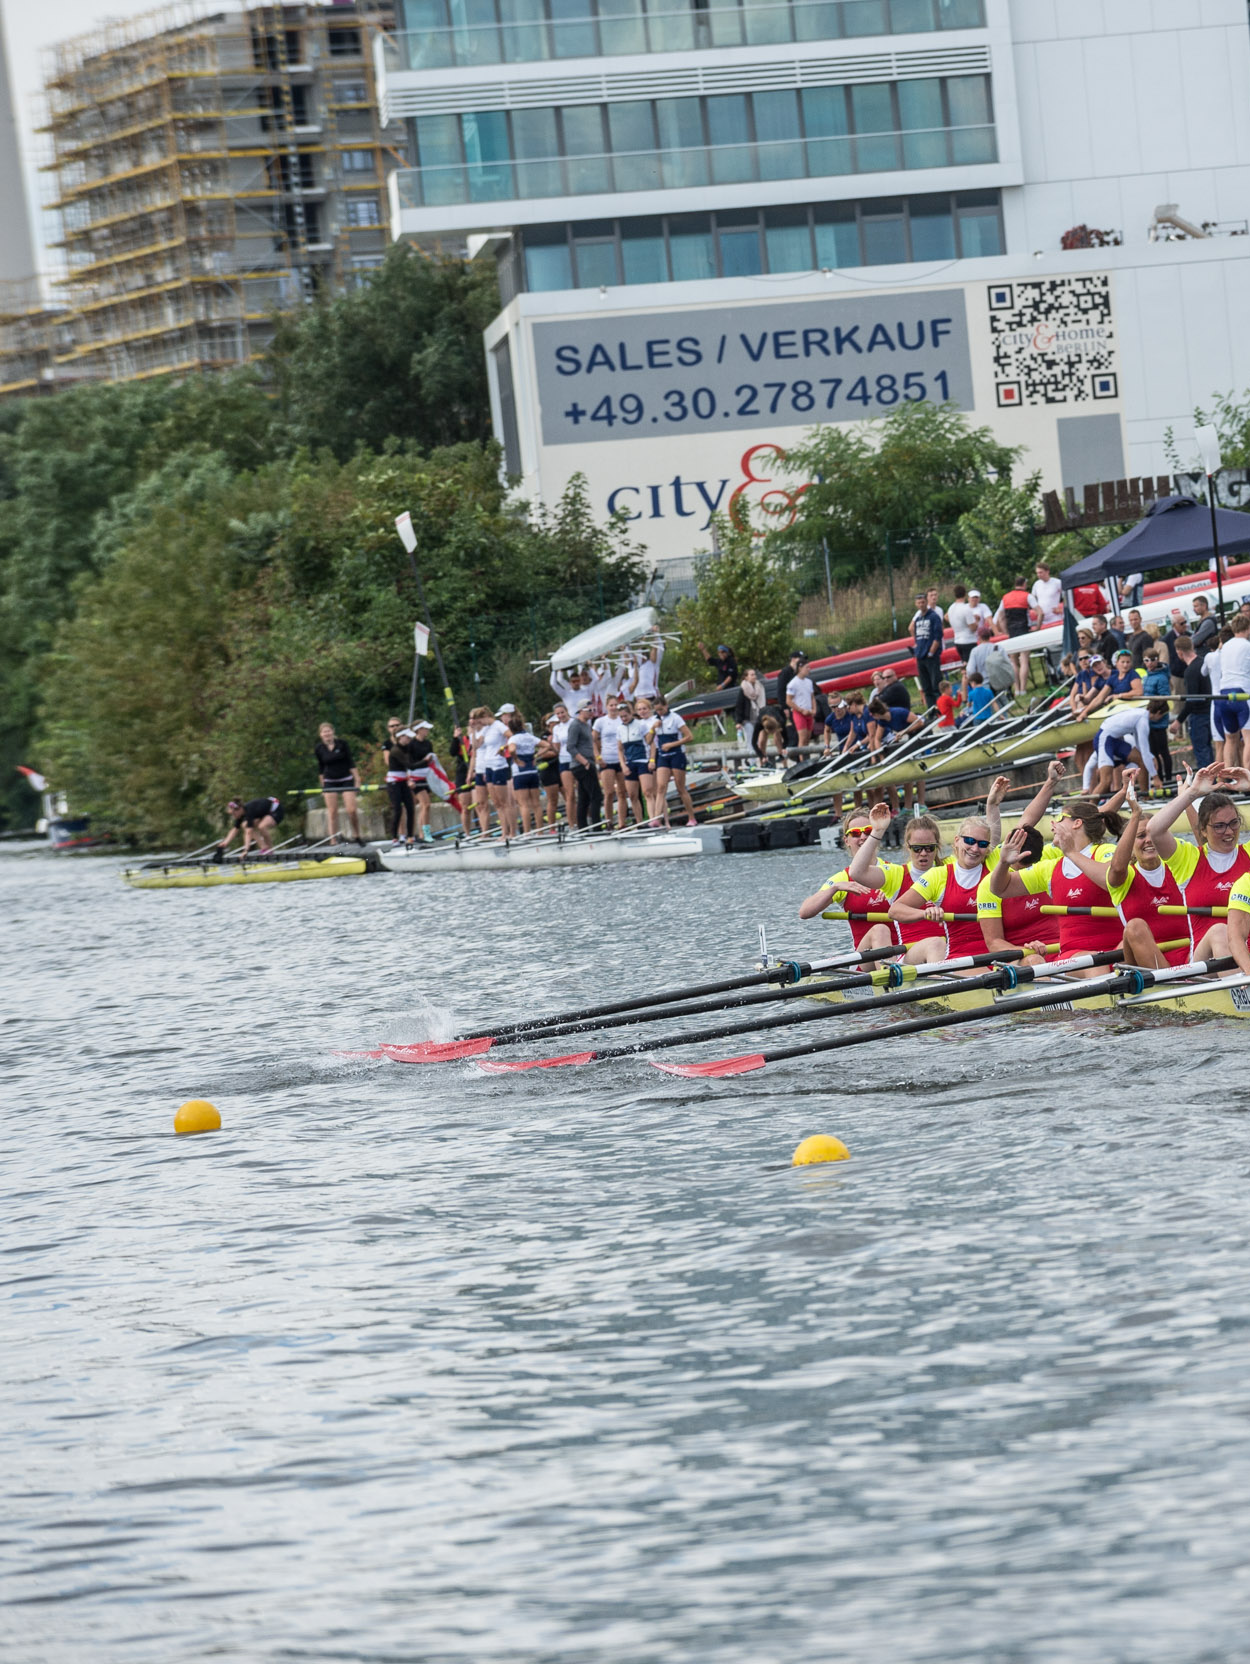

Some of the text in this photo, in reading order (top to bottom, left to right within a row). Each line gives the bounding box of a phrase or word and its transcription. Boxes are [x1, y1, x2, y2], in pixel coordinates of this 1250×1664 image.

[555, 318, 952, 376] SALES / VERKAUF
[564, 370, 951, 427] +49.30.27874851
